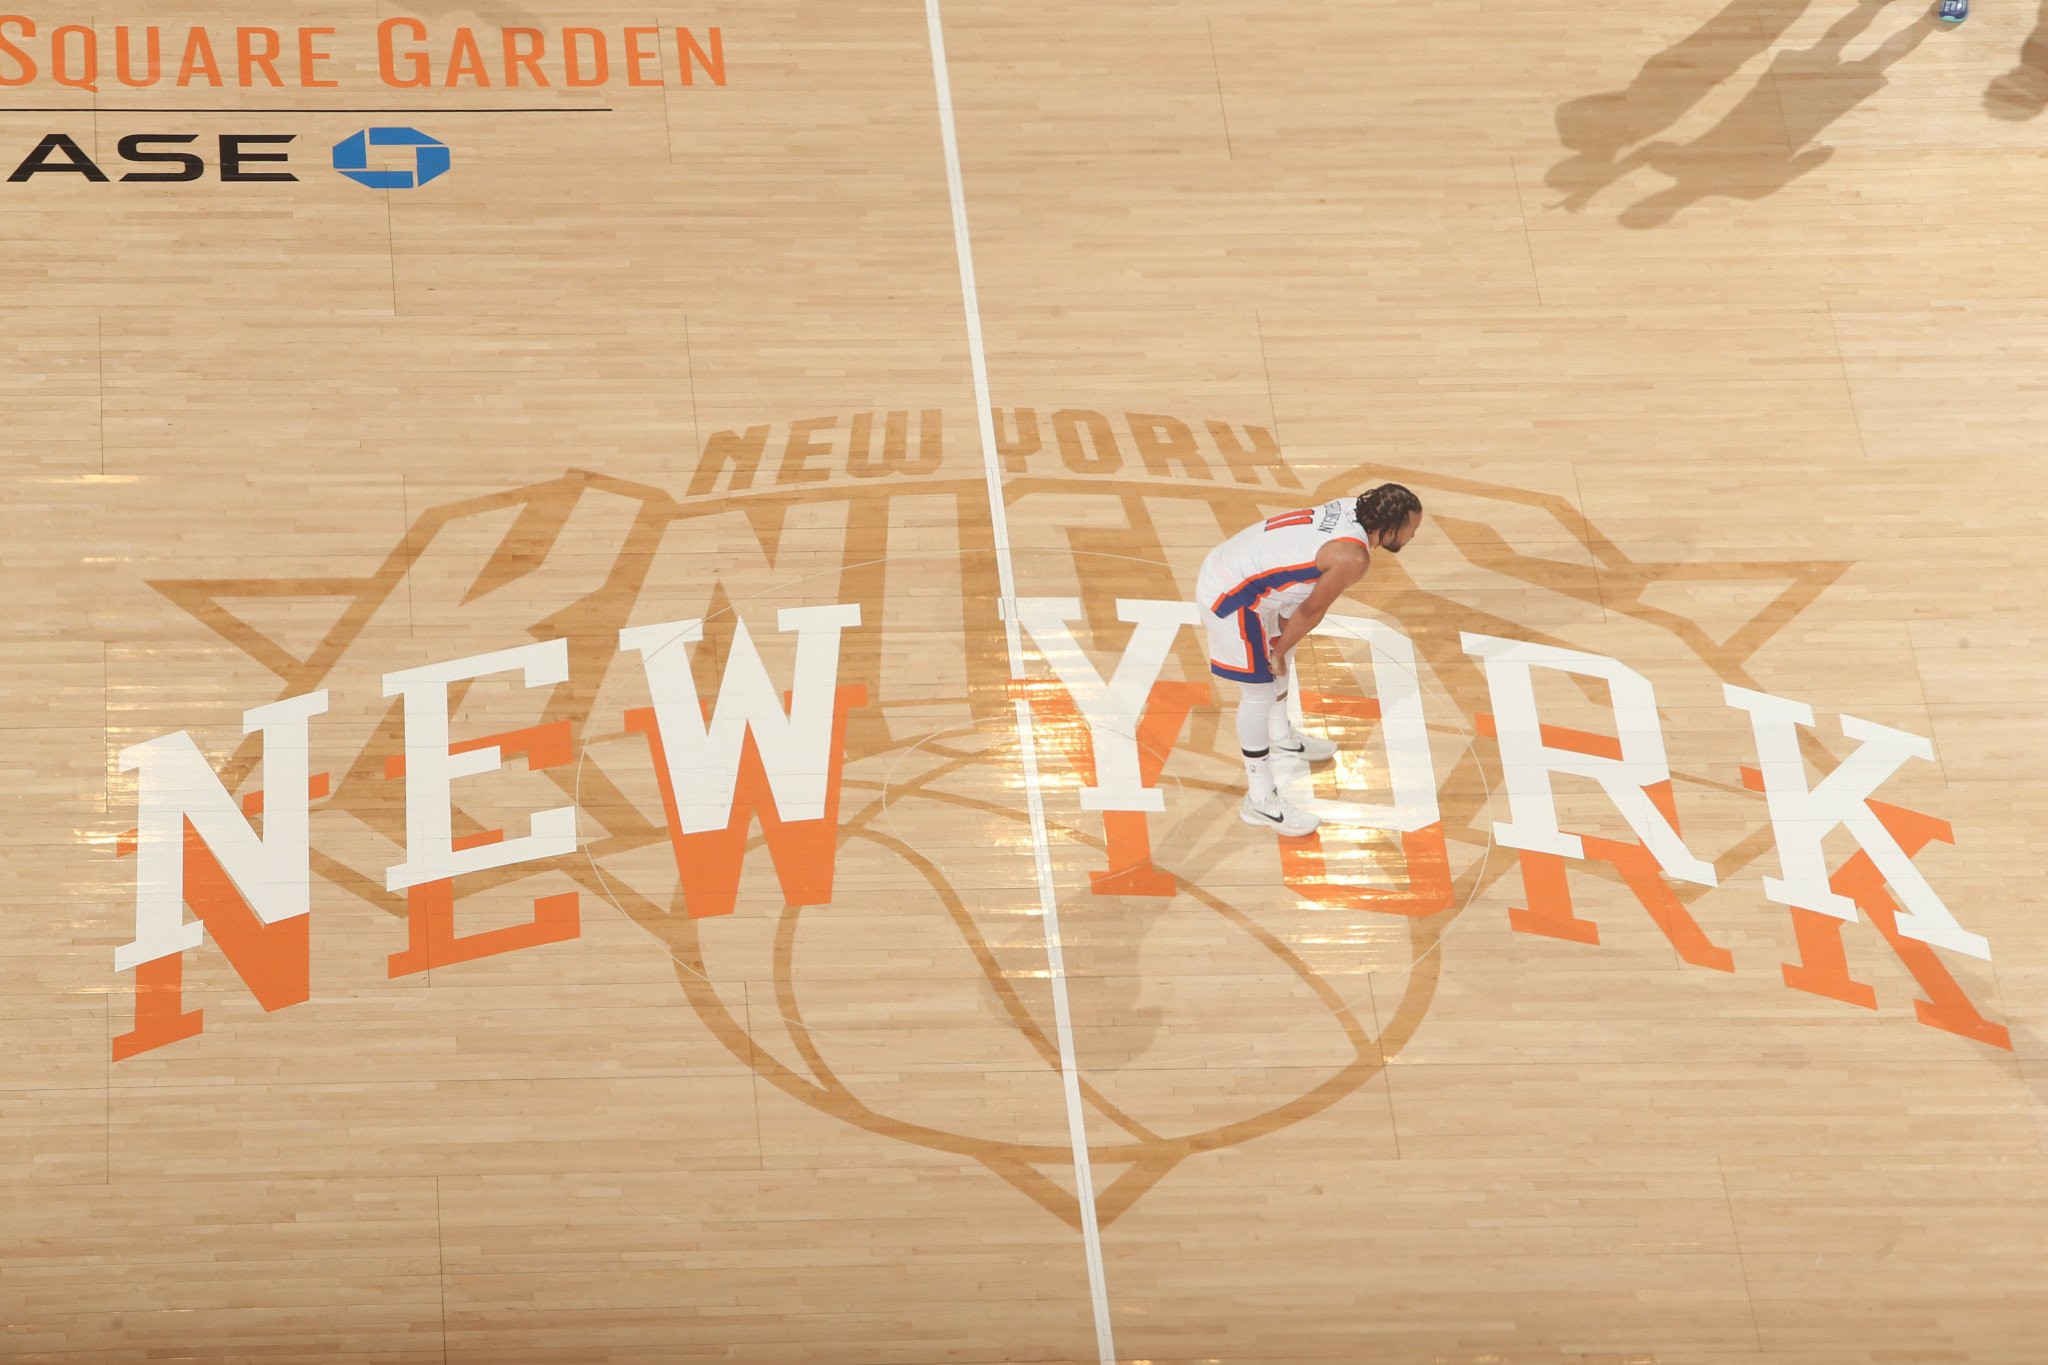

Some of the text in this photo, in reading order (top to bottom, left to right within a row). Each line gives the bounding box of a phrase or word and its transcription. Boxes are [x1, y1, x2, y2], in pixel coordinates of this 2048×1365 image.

[0, 15, 727, 93] SQUARE GARDEN
[6, 133, 301, 182] ASE
[684, 407, 1305, 497] NEW YORK
[1264, 508, 1315, 532] 11
[112, 596, 2012, 1062] NEW YORK
